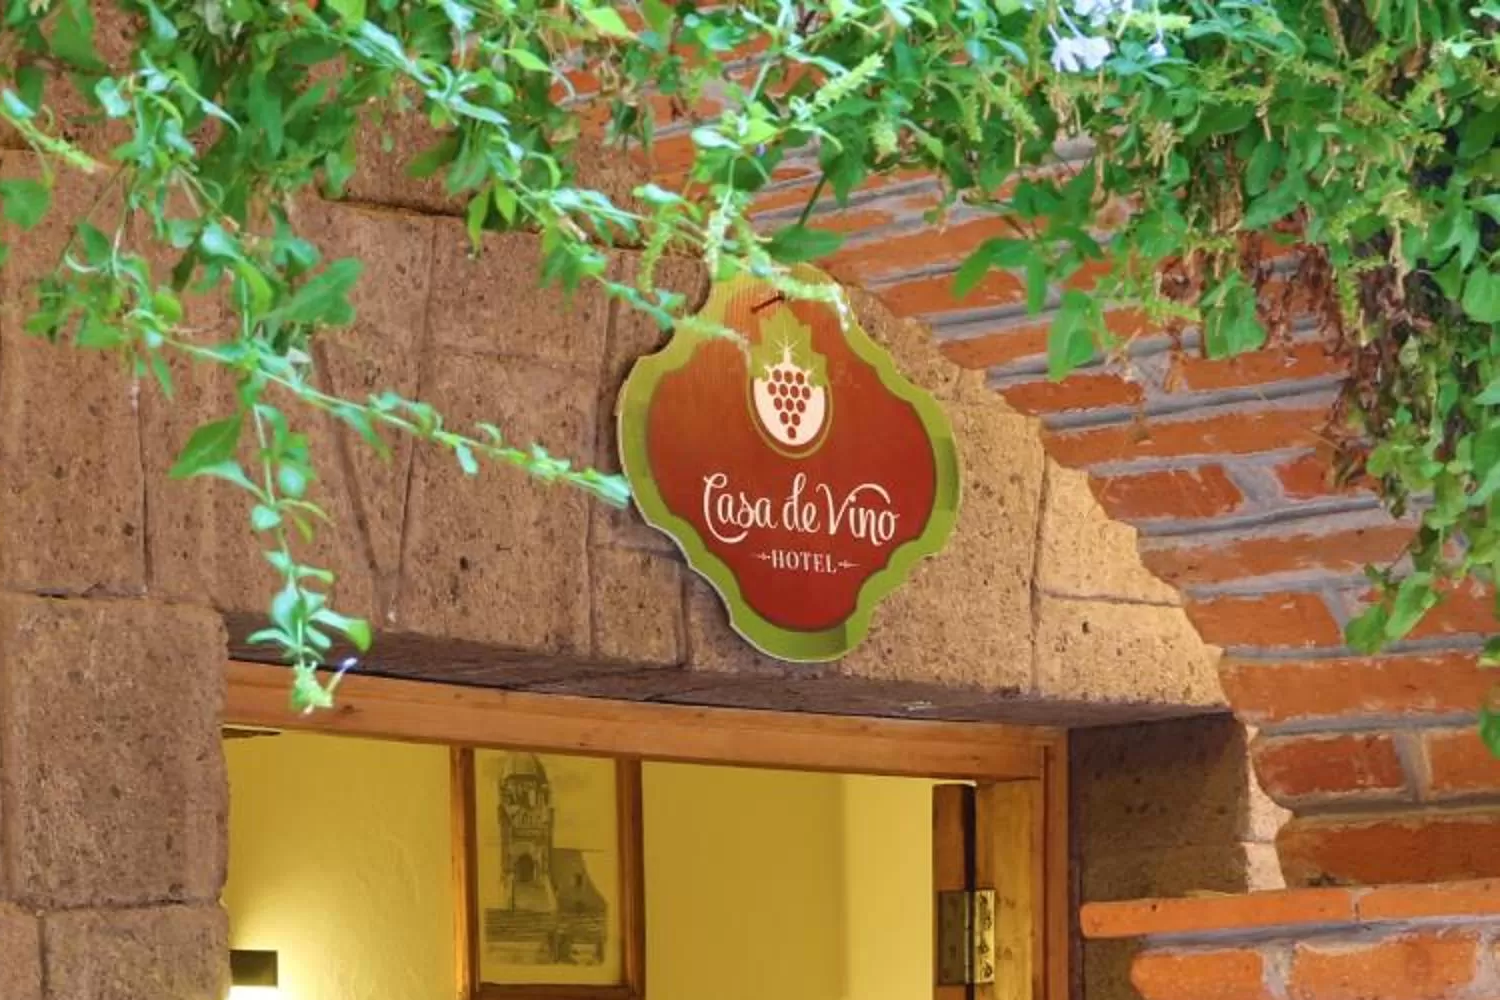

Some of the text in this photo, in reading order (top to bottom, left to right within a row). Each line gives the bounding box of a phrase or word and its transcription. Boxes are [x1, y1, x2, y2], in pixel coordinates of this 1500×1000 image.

[703, 472, 900, 546] Casa de Vino
[771, 549, 837, 574] HOTEL
